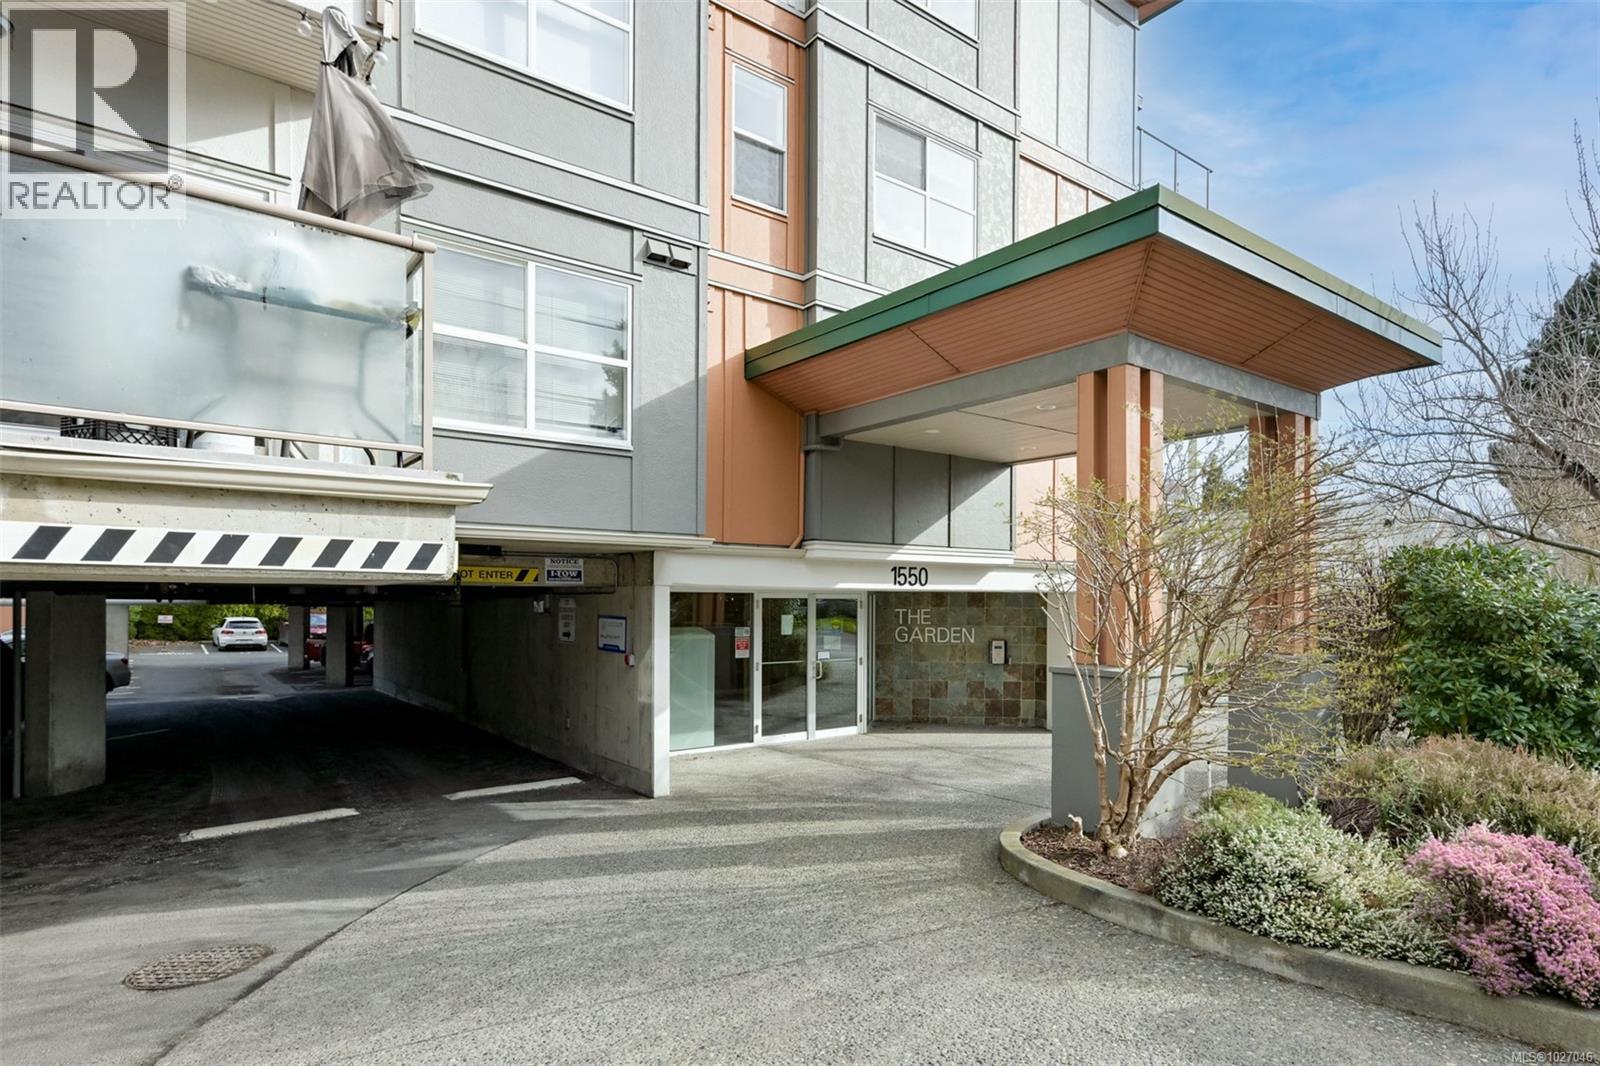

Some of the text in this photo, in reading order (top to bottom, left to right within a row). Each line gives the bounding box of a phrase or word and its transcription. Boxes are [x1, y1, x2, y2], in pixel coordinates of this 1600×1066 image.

[458, 569, 513, 579] OT ENTER
[890, 566, 929, 587] 1550
[895, 608, 931, 625] THE
[895, 627, 975, 644] GARDEN
